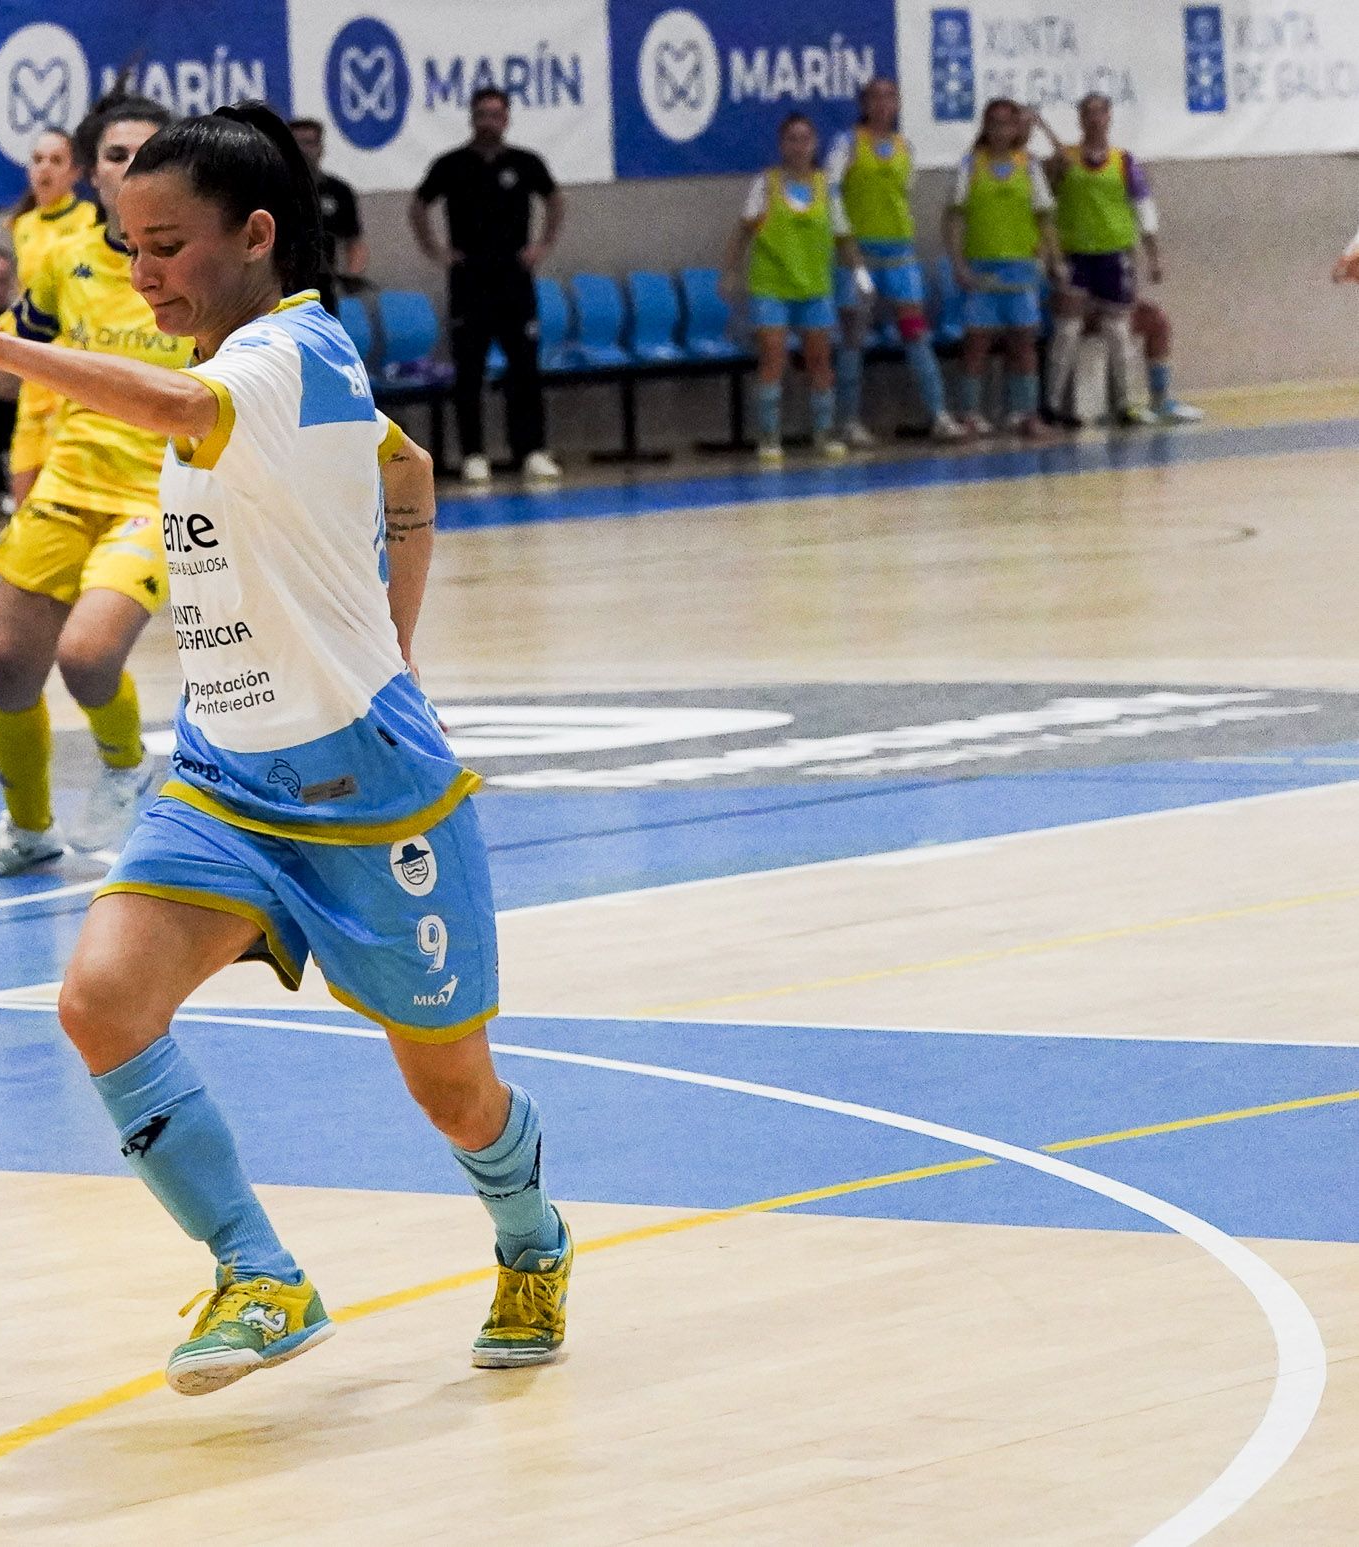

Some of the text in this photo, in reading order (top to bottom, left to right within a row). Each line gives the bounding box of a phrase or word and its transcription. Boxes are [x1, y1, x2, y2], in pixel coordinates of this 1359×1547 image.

[728, 32, 876, 103] MARÍN
[416, 914, 448, 975] 9
[413, 994, 447, 1007] MKA
